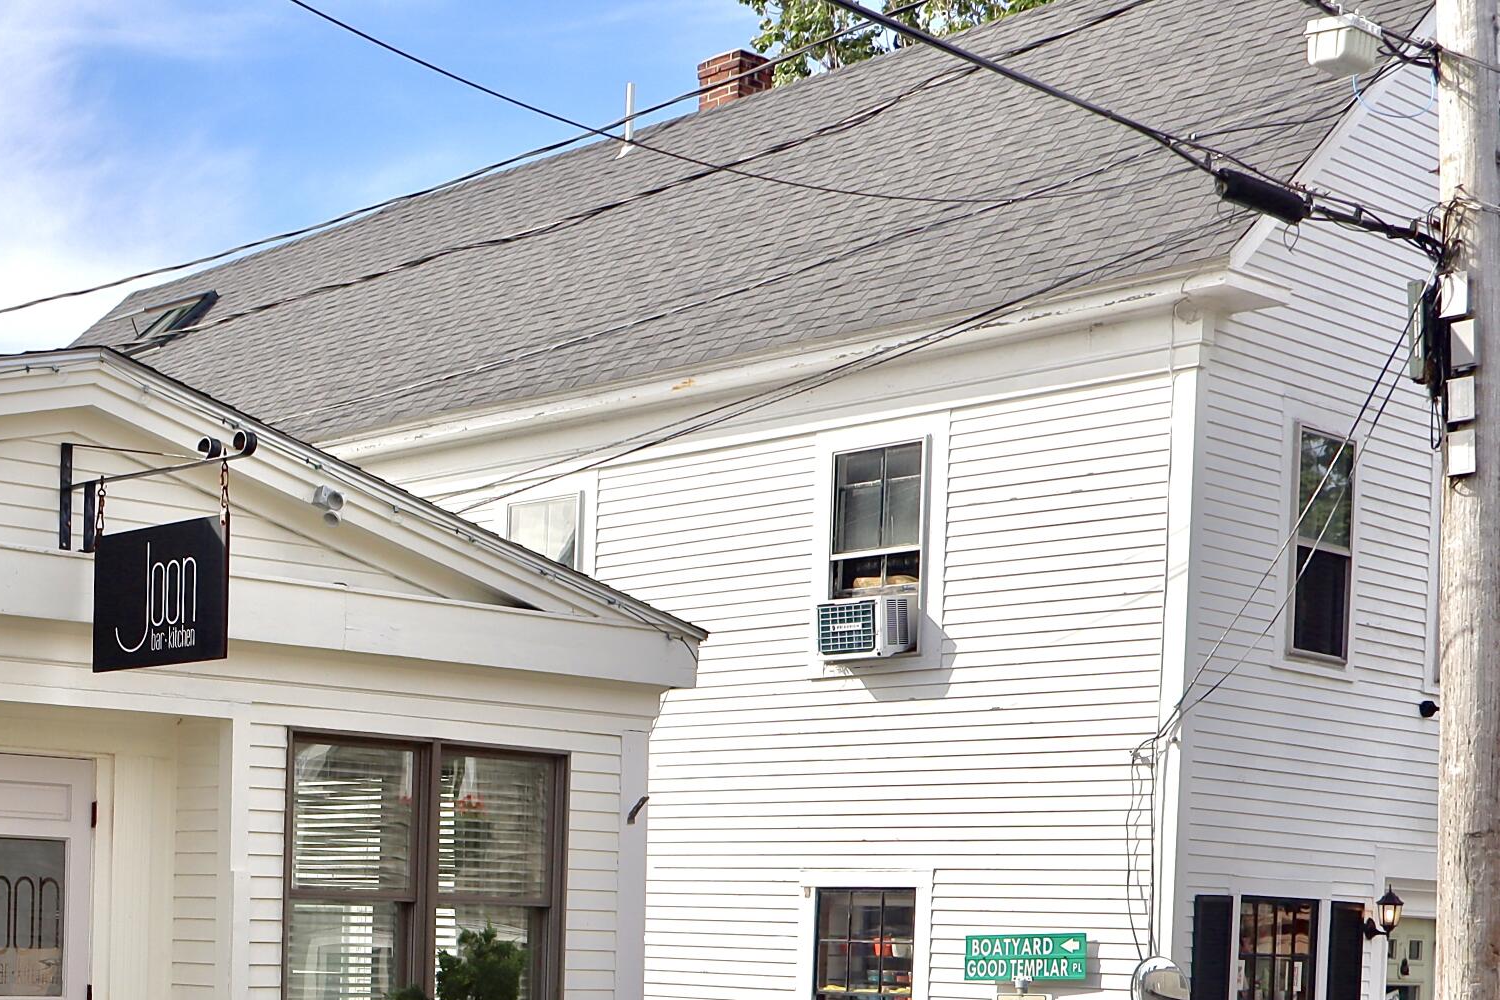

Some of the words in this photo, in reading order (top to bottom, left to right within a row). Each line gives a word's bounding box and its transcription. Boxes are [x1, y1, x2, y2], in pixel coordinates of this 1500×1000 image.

[115, 541, 197, 653] Joon
[971, 937, 1053, 957] BOATYARD
[967, 959, 1007, 977] GOOD
[1010, 958, 1068, 978] TEMPLAR
[1072, 963, 1082, 973] PL
